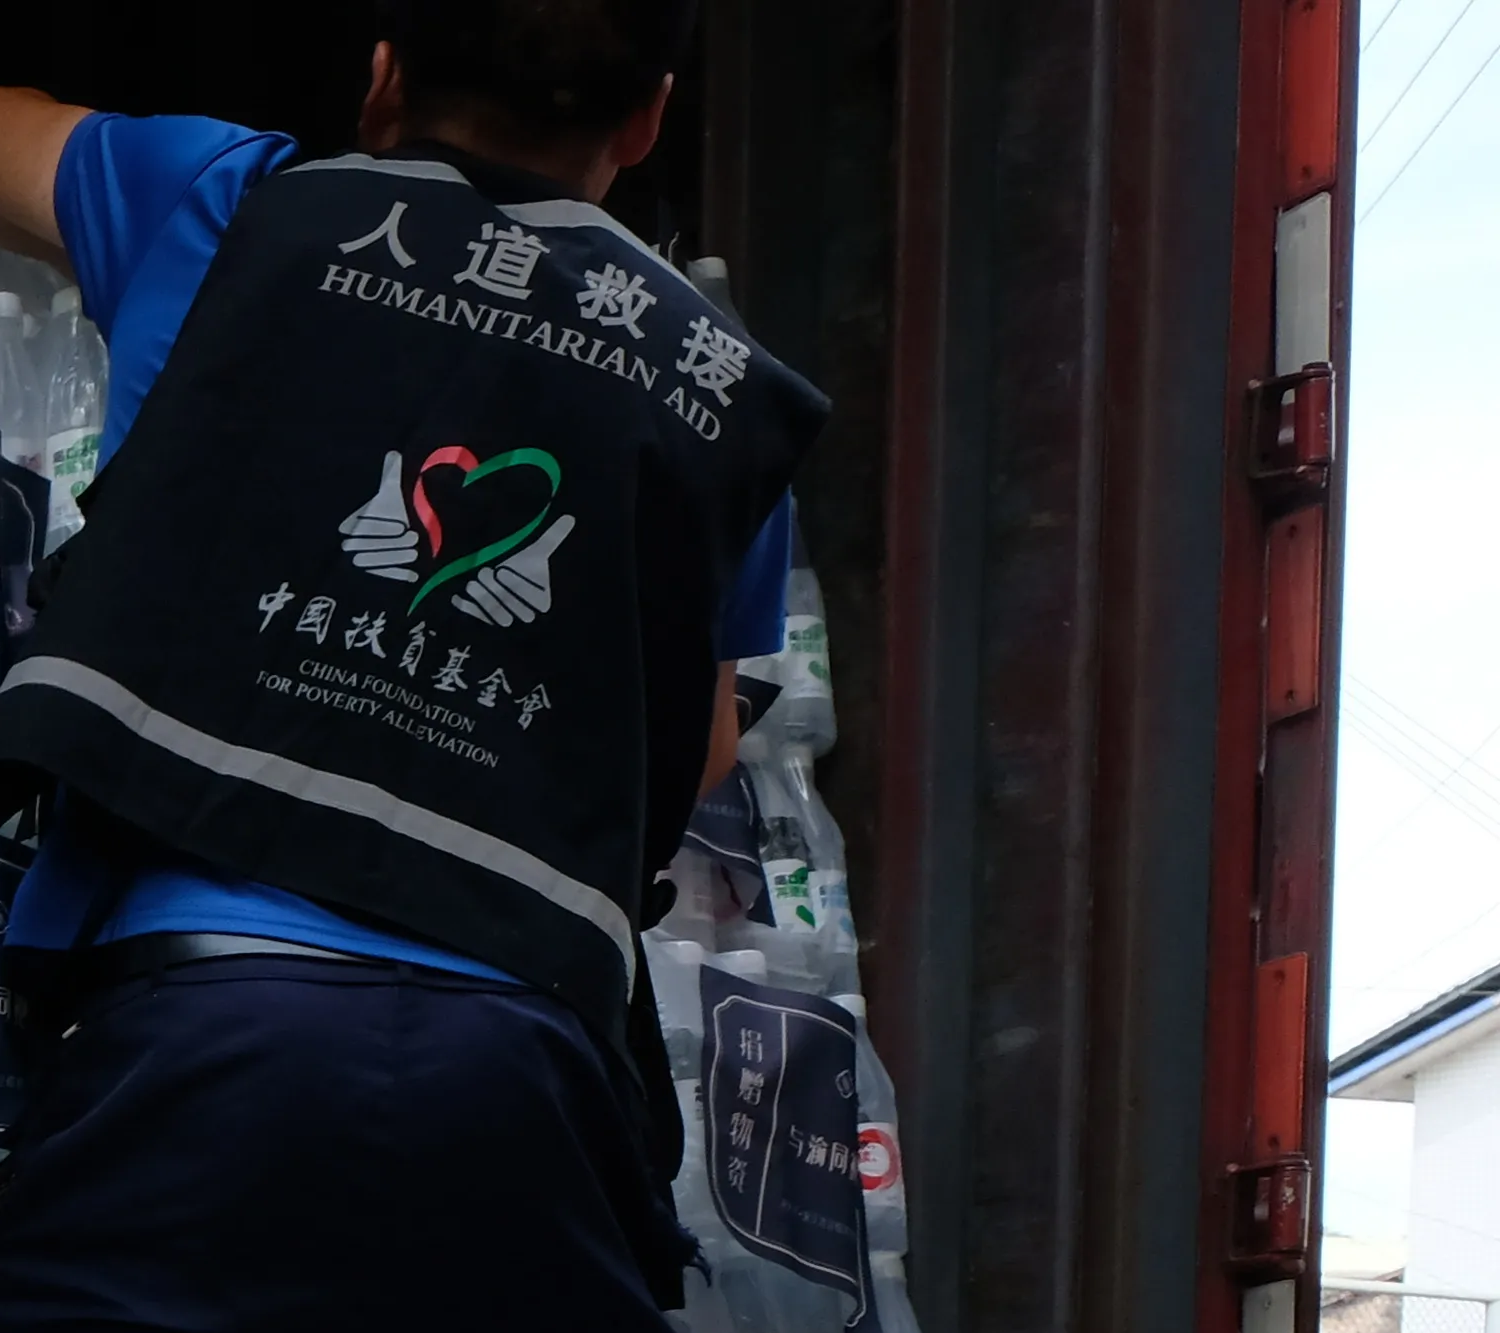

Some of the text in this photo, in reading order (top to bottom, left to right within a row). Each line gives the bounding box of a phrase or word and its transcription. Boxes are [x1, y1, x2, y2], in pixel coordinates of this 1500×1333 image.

[318, 263, 723, 443] HUMANITARIAN AID
[337, 201, 751, 408] 人道救援
[255, 668, 501, 769] FOR POVERTY ALLEVIATION
[298, 657, 477, 734] CHINA FOUNDATION
[787, 1124, 858, 1183] 与渝同
